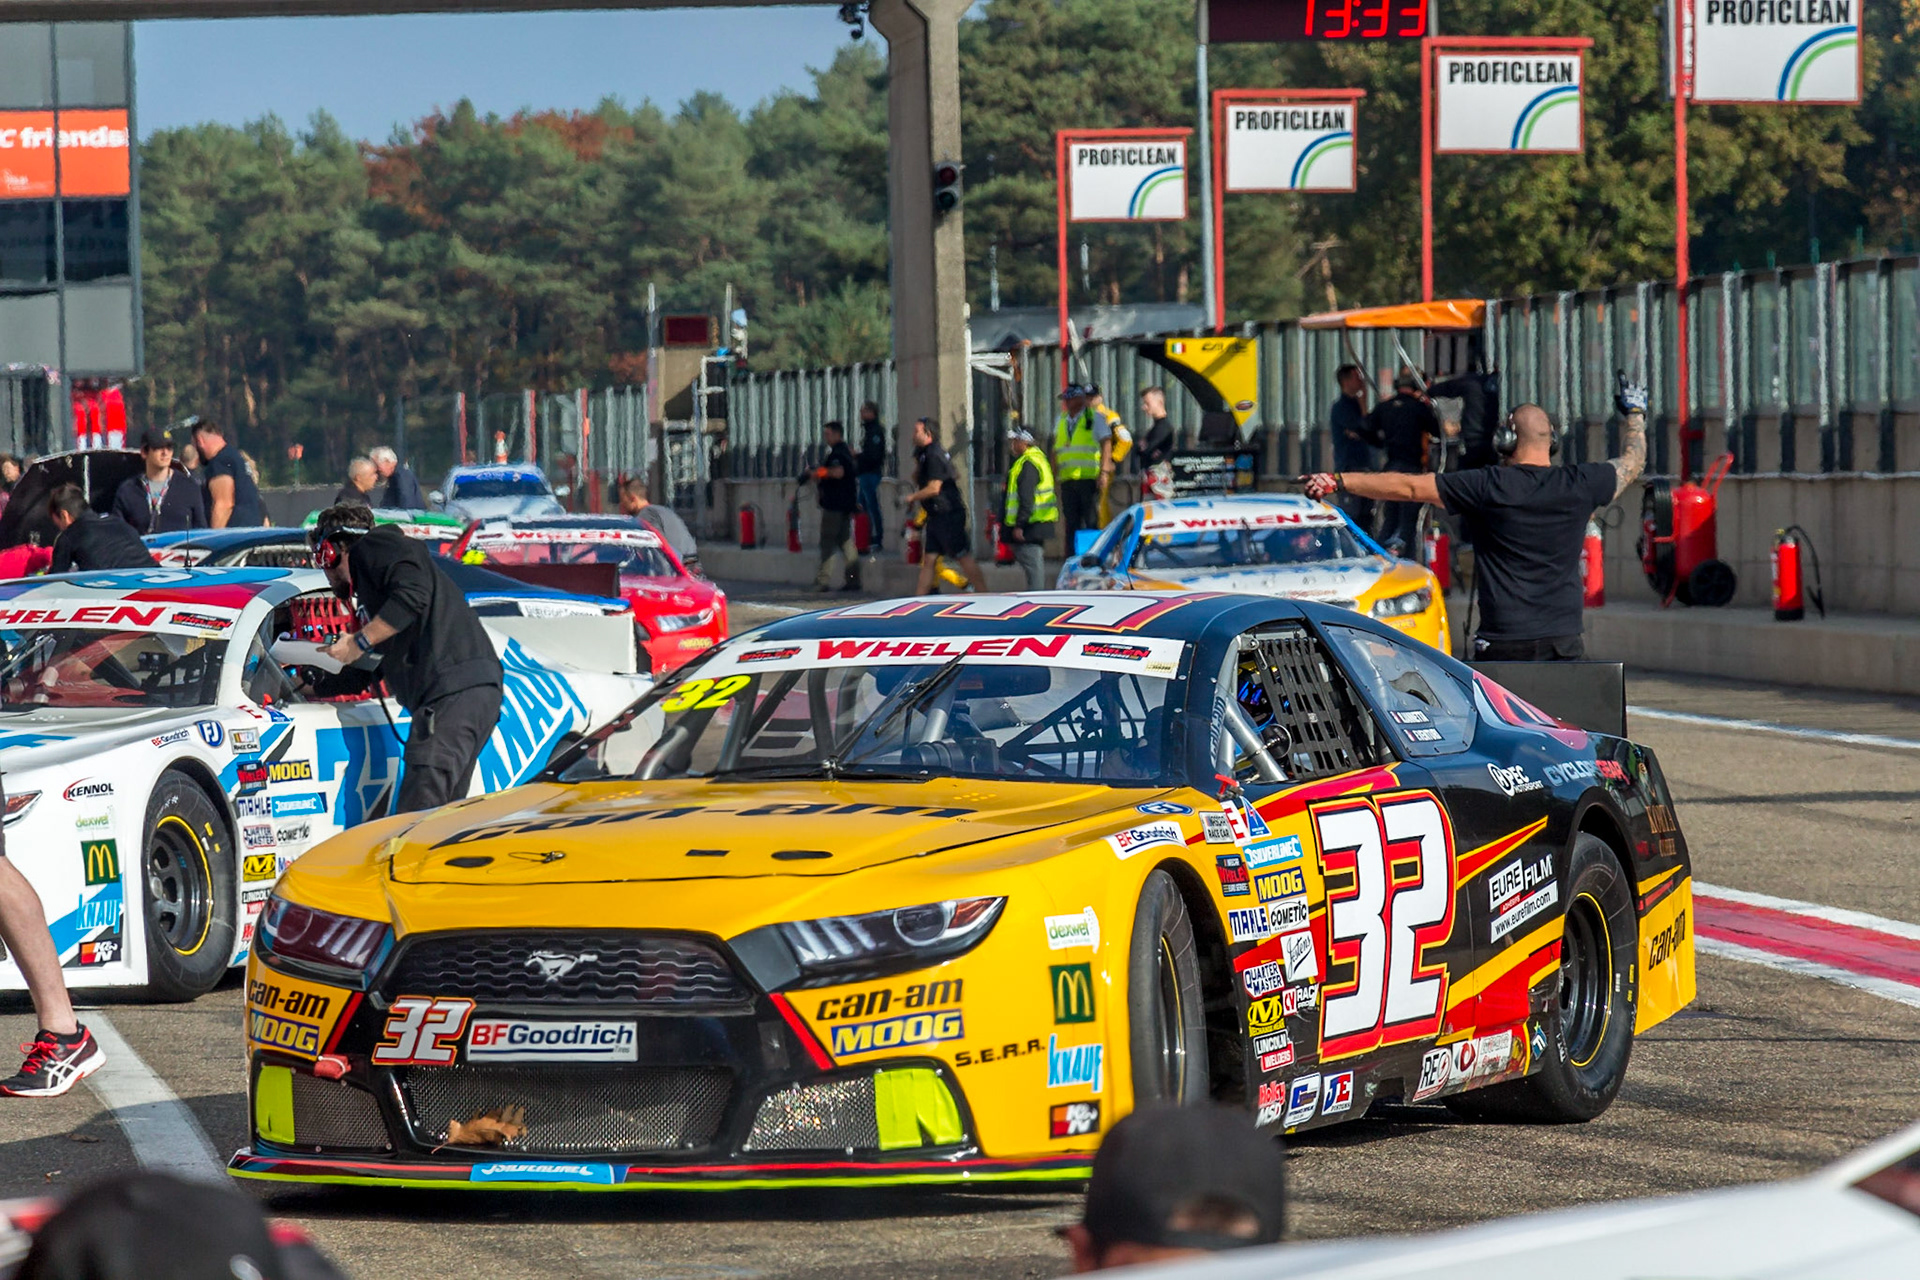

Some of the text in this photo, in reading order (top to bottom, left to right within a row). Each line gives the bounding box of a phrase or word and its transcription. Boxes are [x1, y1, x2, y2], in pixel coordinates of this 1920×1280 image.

[1706, 0, 1850, 25] PROFICLEAN
[1449, 61, 1573, 83] PROFICLEAN
[1235, 111, 1346, 131] PROFICLEAN
[1078, 148, 1177, 166] PROFICLEAN
[1180, 513, 1302, 529] WHELEN
[816, 634, 1073, 661] WHELEN
[1083, 645, 1152, 658] WHELEN
[662, 674, 751, 713] 32
[151, 728, 190, 746] BFGoodrich
[202, 721, 220, 743] FJ
[268, 761, 311, 781] MOOG
[67, 783, 115, 799] KENNOL
[238, 796, 271, 817] MAHLE
[428, 802, 979, 851] can-am
[1114, 827, 1178, 849] BFGoodrich
[1207, 828, 1230, 839] RACE CAR
[1257, 869, 1303, 901] MOOG
[1491, 865, 1521, 902] EURE
[1524, 853, 1553, 891] FILM
[76, 893, 123, 934] KNAUF
[1228, 908, 1269, 936] MAHLE
[1270, 901, 1307, 927] COMETIC
[1312, 794, 1452, 1050] 32
[1494, 891, 1551, 935] www.eurefilm.com
[1648, 908, 1686, 971] can-am
[1245, 962, 1279, 988] QUARTER
[1253, 975, 1283, 996] MASTER
[250, 979, 331, 1020] can-am
[816, 978, 964, 1021] can-am
[251, 1011, 319, 1052] MOOG
[373, 996, 476, 1064] 32
[470, 1023, 634, 1046] BFGoodrich
[834, 1011, 962, 1055] MOOG
[1255, 1033, 1287, 1055] LINCOLN
[1047, 1033, 1103, 1093] KNAUF
[1263, 1049, 1291, 1068] WELDERS
[1258, 1080, 1286, 1109] Holley
[1323, 1073, 1352, 1112] JE
[1255, 1102, 1282, 1128] MSD
